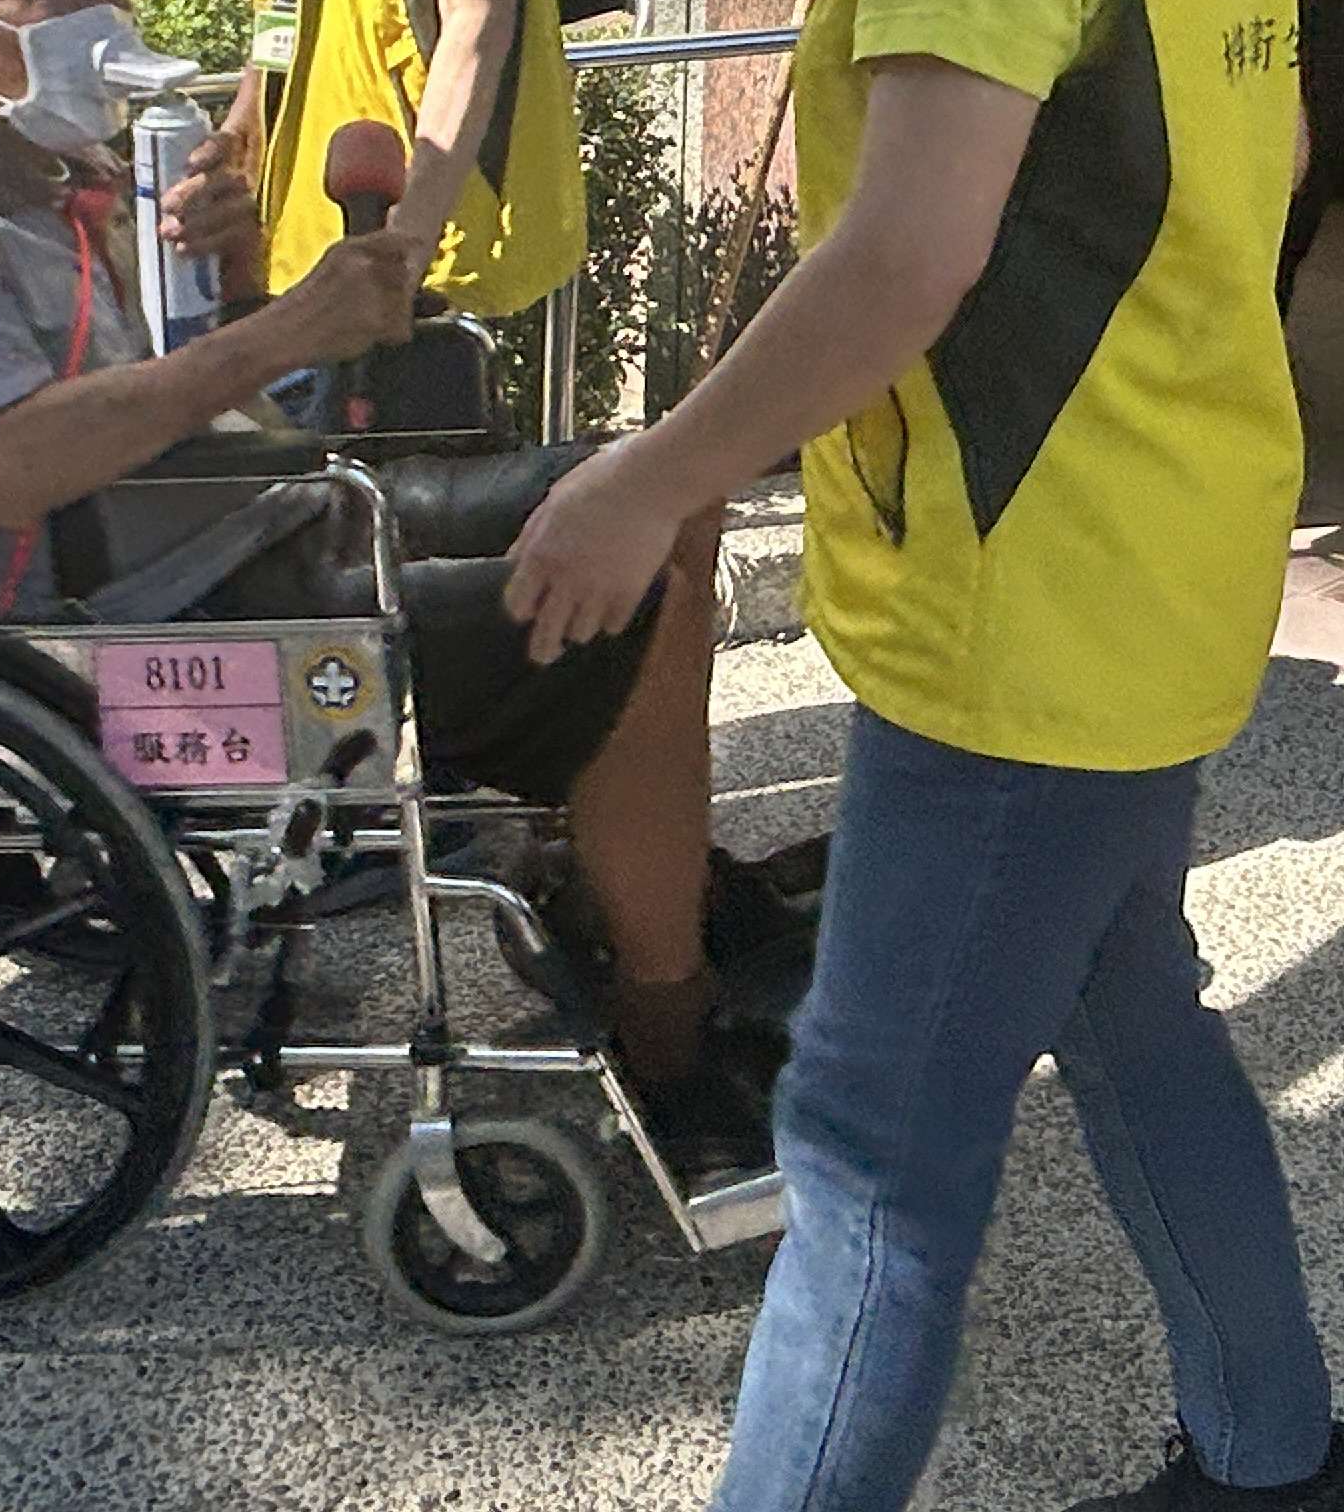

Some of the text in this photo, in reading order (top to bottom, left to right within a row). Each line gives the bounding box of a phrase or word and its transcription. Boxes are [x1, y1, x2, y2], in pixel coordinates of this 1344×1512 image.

[145, 655, 226, 690] 8101
[133, 728, 251, 764] 服務台
